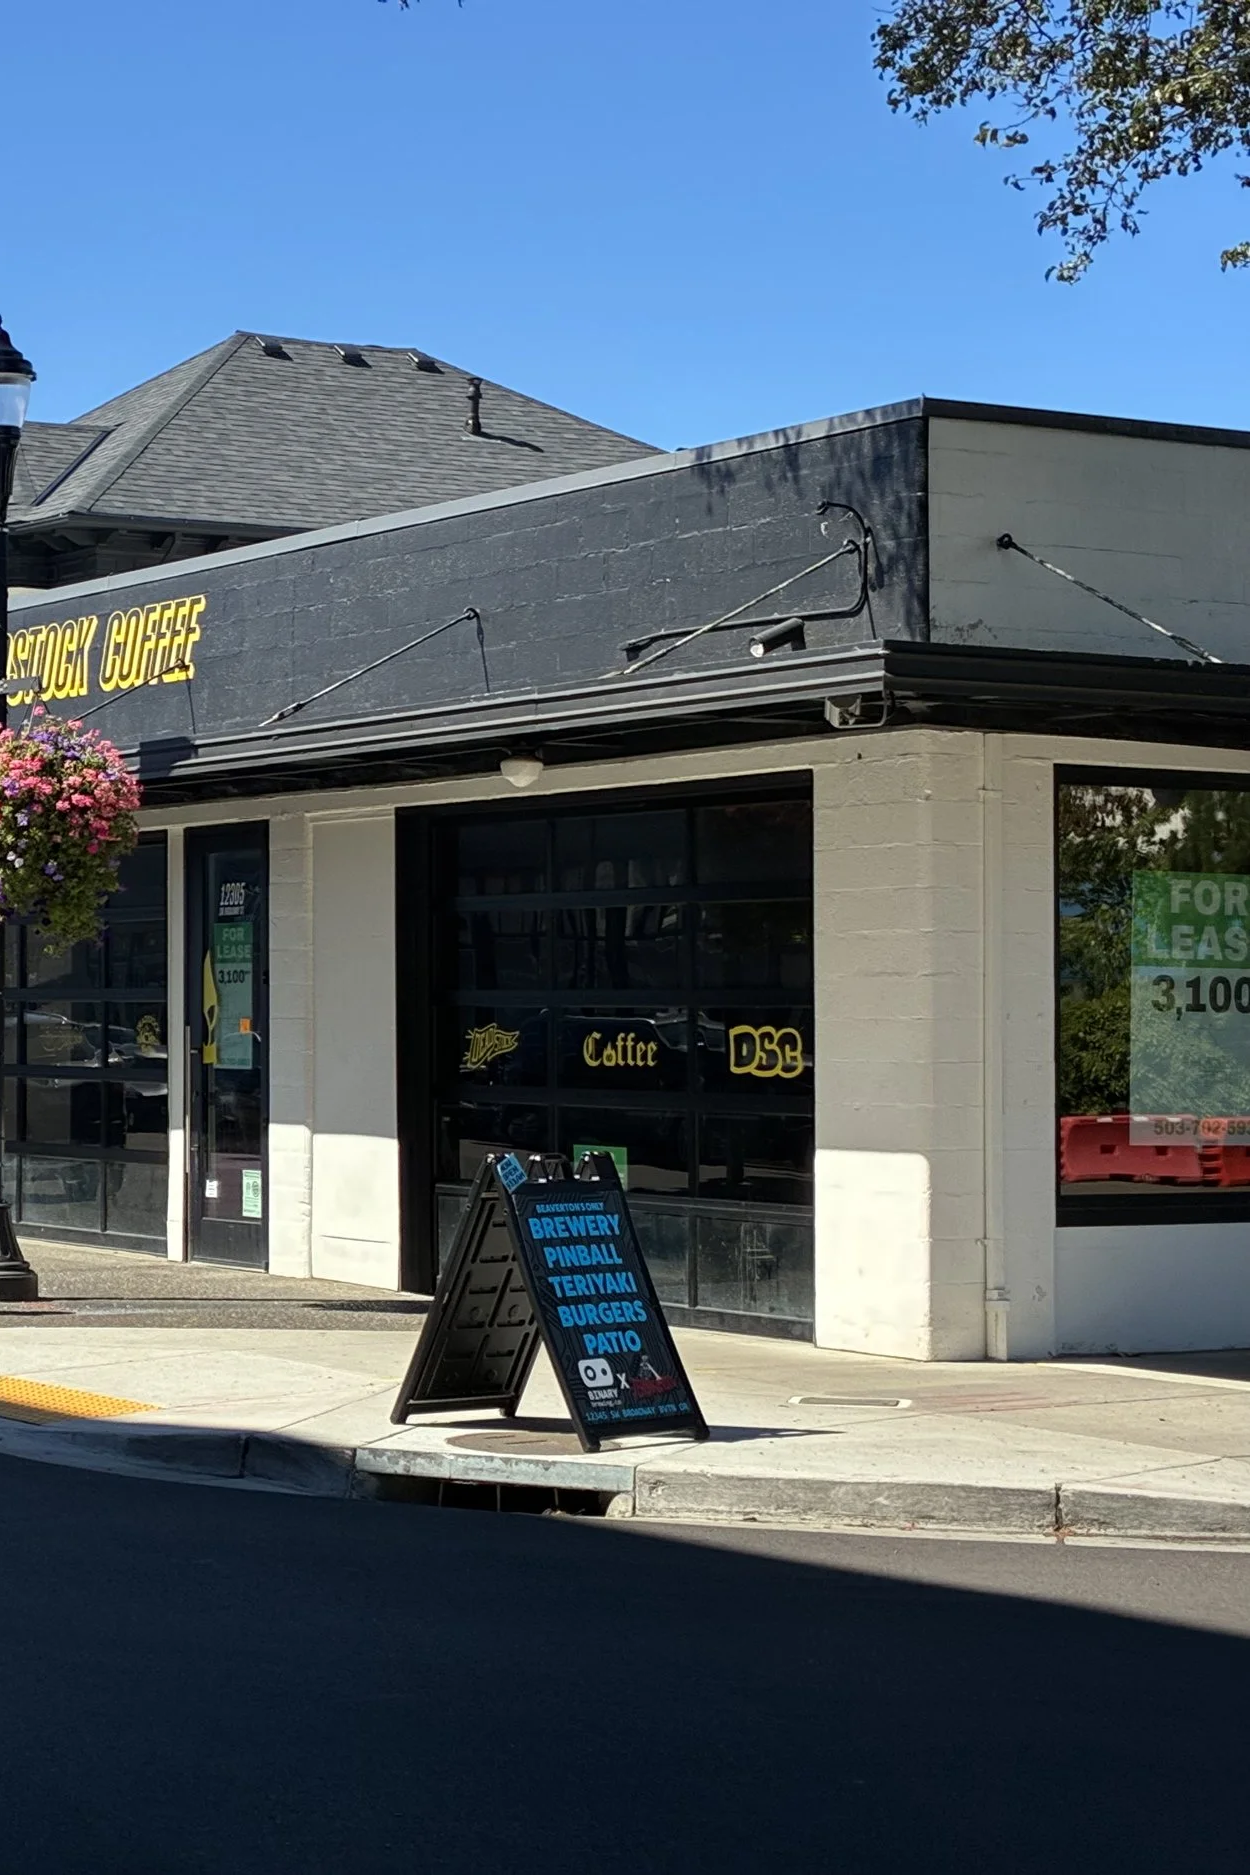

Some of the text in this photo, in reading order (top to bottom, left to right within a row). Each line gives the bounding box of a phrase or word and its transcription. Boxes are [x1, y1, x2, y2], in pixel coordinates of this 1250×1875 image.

[99, 594, 206, 692] COFFEE
[220, 882, 246, 906] 12305
[1170, 879, 1249, 916] FOR
[222, 928, 245, 941] FOR
[1146, 925, 1249, 962] LEAS
[217, 944, 251, 958] LEASE
[218, 970, 245, 984] 3,100
[583, 1031, 658, 1068] Coffee
[729, 1026, 803, 1078] DSC
[528, 1214, 621, 1240] BREWERY
[543, 1243, 623, 1269] PINBALL
[548, 1272, 638, 1298] TERIYAKI
[557, 1300, 648, 1328] BURGERS
[583, 1330, 642, 1355] PATIO
[587, 1389, 618, 1401] BINARY
